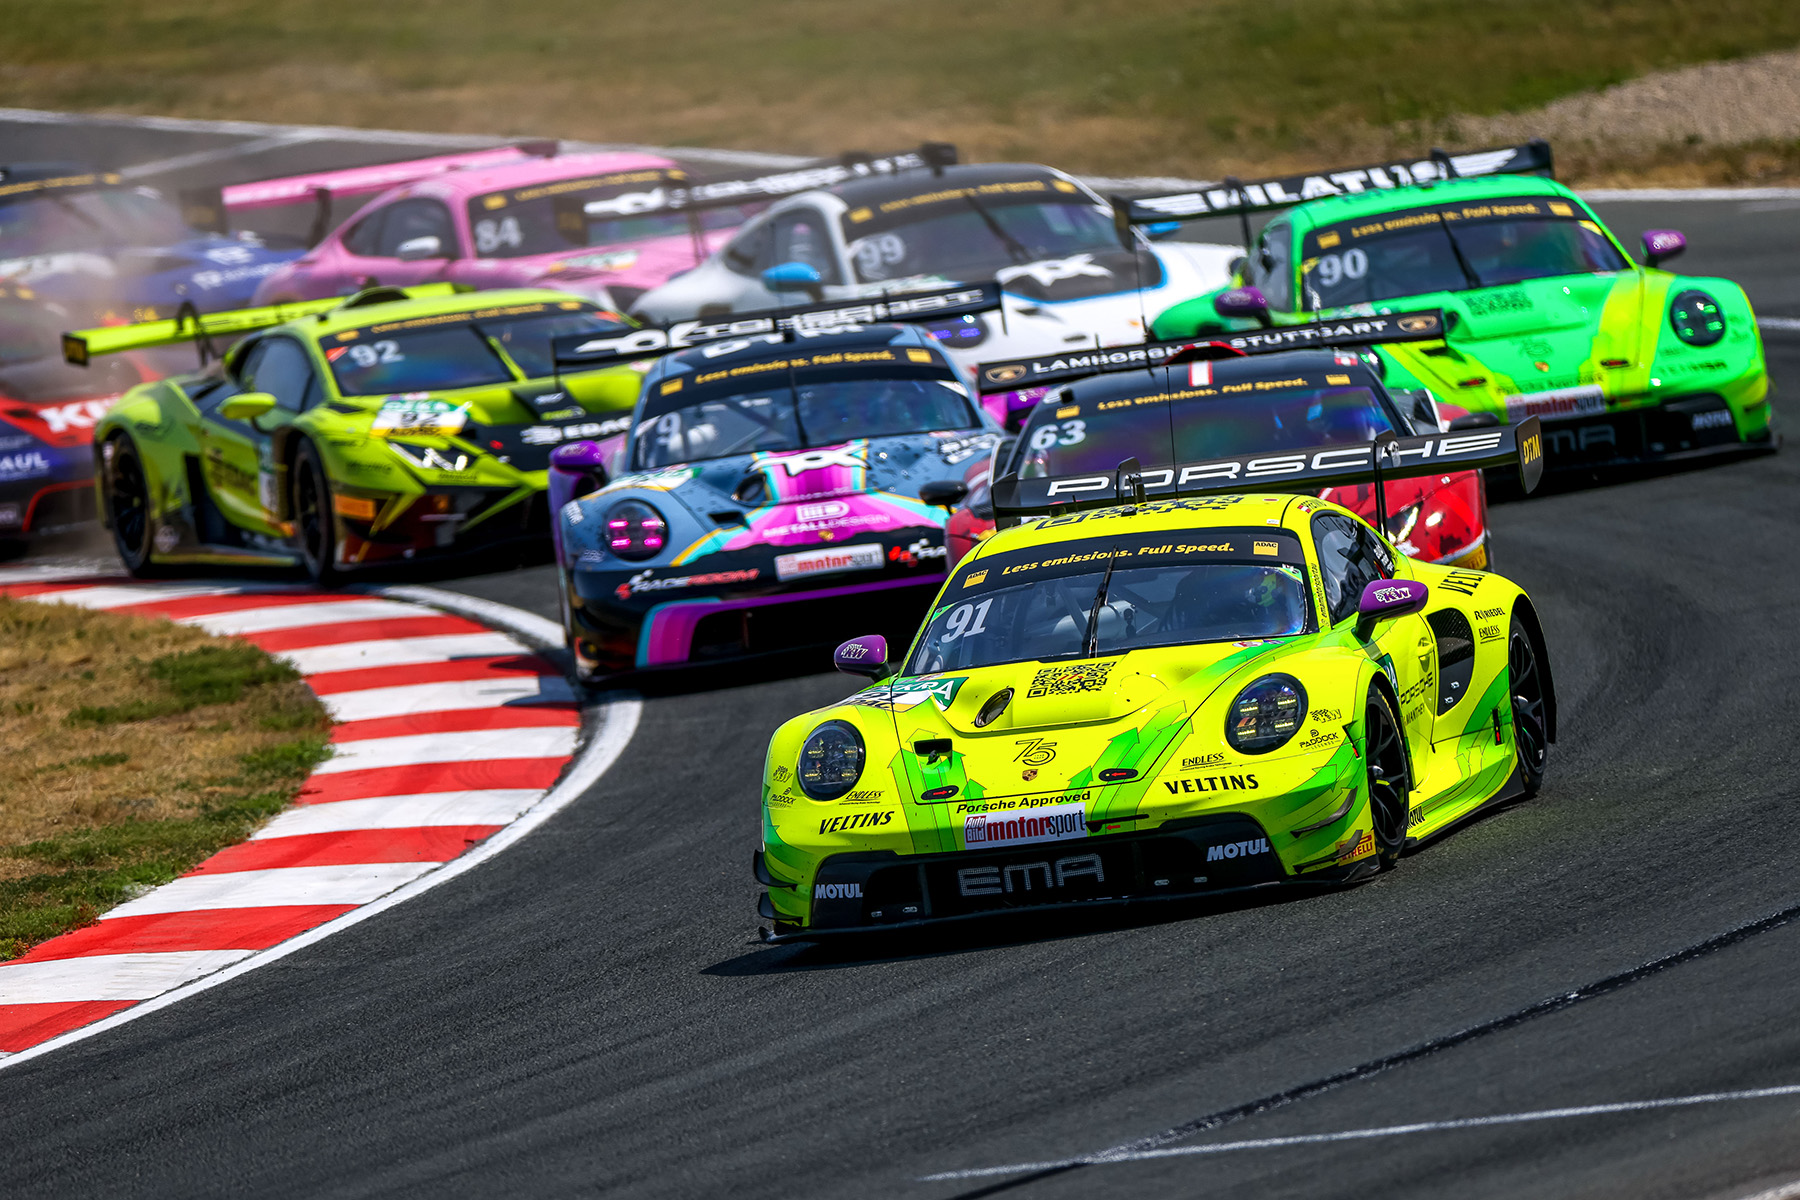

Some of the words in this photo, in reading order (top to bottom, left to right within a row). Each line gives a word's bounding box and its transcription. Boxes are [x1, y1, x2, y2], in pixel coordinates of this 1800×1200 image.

[475, 216, 522, 252] 84
[858, 234, 906, 280] 99
[1318, 248, 1369, 287] 90
[1230, 320, 1387, 349] STUTTGART
[350, 340, 404, 367] 92
[695, 370, 728, 384] Less
[812, 353, 843, 365] Full
[846, 350, 895, 363] Speed.
[1097, 398, 1132, 411] Less
[1134, 388, 1218, 405] emissions.
[1222, 382, 1253, 394] Full
[1255, 378, 1308, 391] Speed.
[657, 412, 682, 445] 9
[1030, 419, 1086, 450] 63
[1523, 433, 1540, 465] DTM
[1047, 432, 1502, 497] PORSCHE
[1002, 561, 1038, 575] Less
[1042, 549, 1132, 568] emissions.
[1138, 544, 1173, 556] Full
[1175, 542, 1234, 555] Speed.
[941, 598, 993, 643] 91
[1479, 625, 1500, 637] ENDLESS
[1401, 672, 1433, 707] PORSCHE
[1013, 738, 1057, 766] 75
[1299, 732, 1339, 748] PADDOCK
[1182, 752, 1225, 766] ENDLESS
[846, 790, 885, 799] ENDLESS
[1164, 774, 1259, 794] VELTINS
[956, 800, 1016, 814] Porsche
[1019, 790, 1091, 808] Approved
[819, 811, 895, 834] VELTINS
[966, 816, 985, 828] Auto
[967, 828, 985, 841] Bild
[987, 810, 1086, 841] motorsport
[1207, 838, 1269, 861] MOTUL
[958, 853, 1104, 896] EMA
[815, 883, 863, 899] MOTUL
